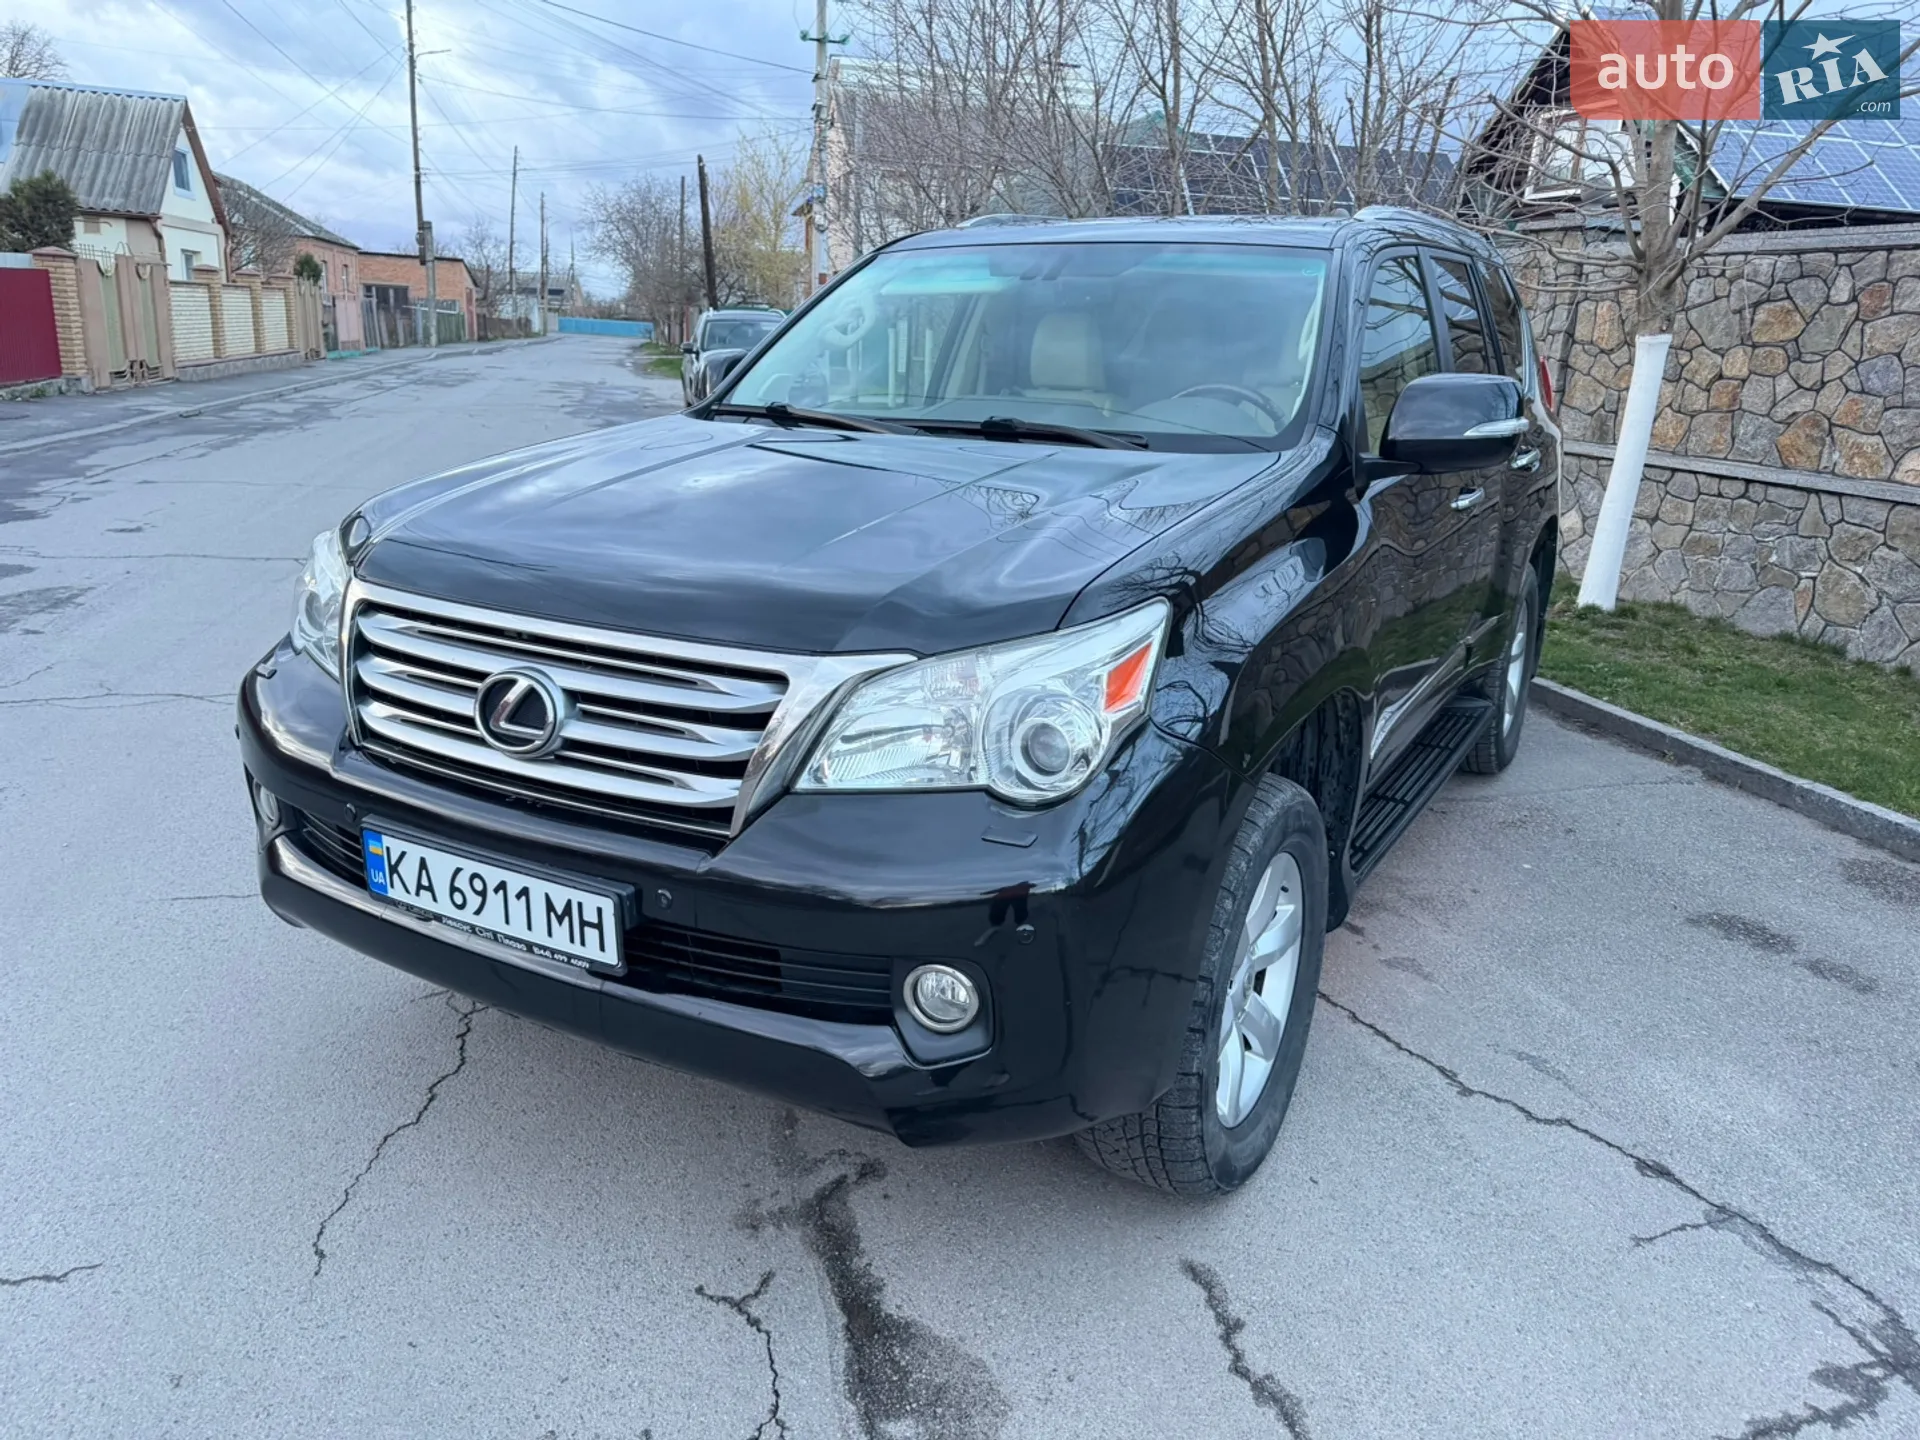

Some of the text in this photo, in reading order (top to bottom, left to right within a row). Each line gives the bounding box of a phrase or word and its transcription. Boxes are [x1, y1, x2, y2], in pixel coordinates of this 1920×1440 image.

[370, 868, 386, 885] UA
[386, 845, 606, 953] KA 6911 MH
